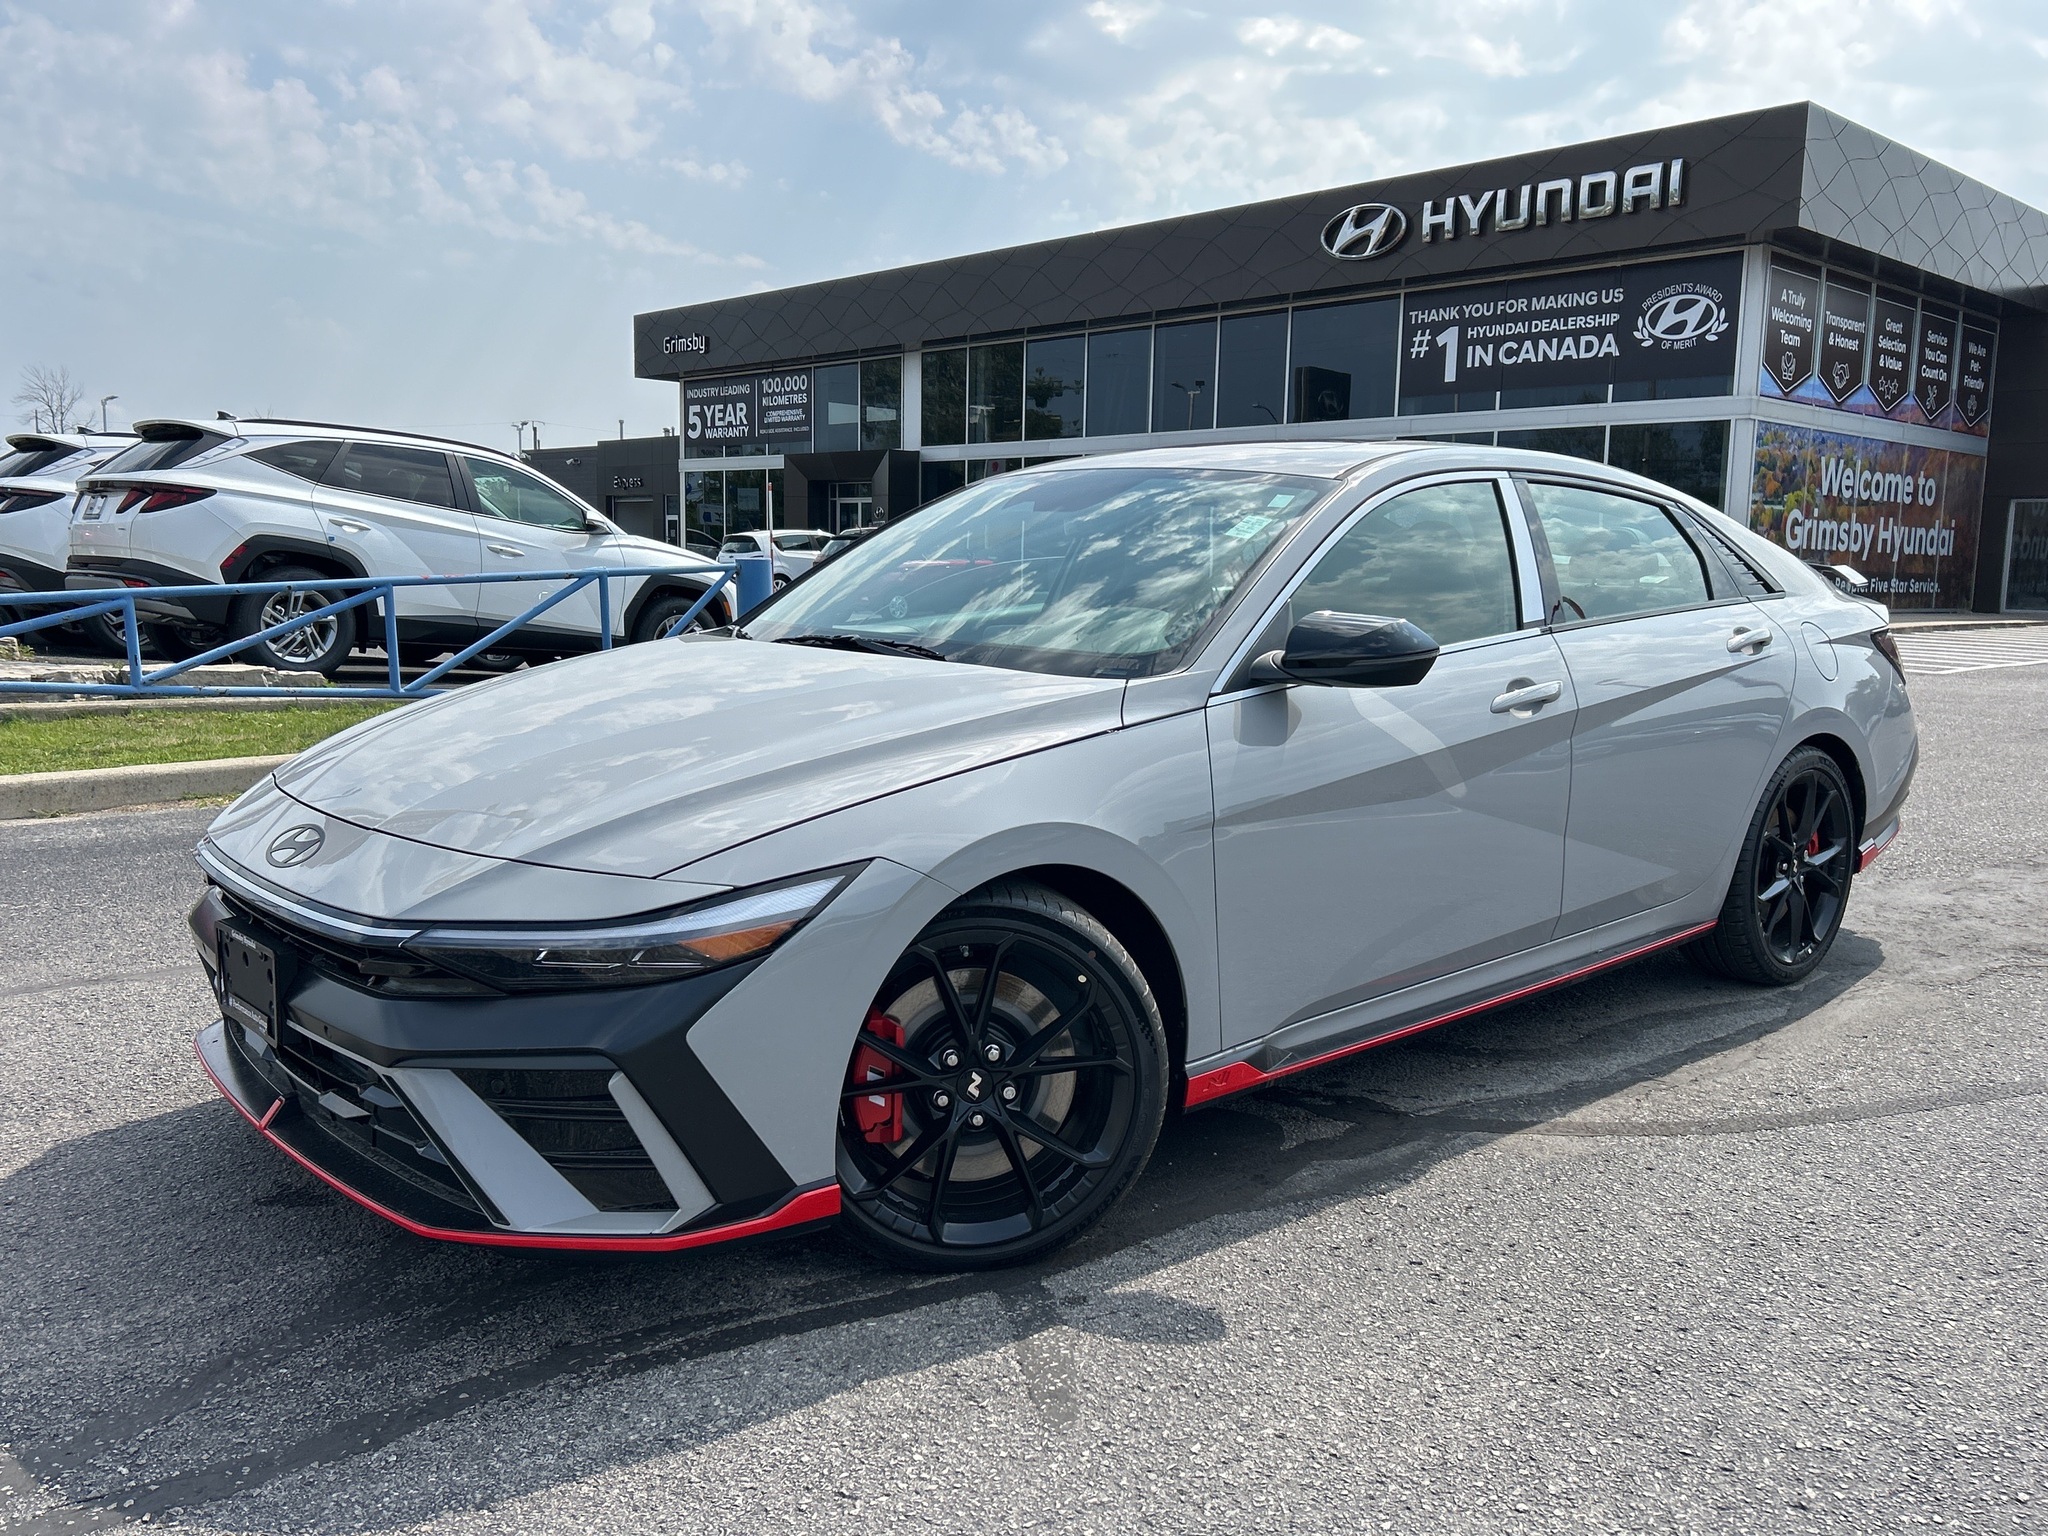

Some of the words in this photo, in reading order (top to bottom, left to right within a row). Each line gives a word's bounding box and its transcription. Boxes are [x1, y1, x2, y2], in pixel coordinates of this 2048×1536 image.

[1422, 158, 1685, 243] HYUNDAI
[1694, 284, 1723, 303] AWARD
[1781, 288, 1787, 303] A
[1788, 290, 1806, 310] Truly
[1409, 306, 1460, 324] THANK
[1462, 302, 1494, 318] YOU
[1497, 299, 1528, 315] FOR
[1531, 291, 1598, 311] MAKING
[1602, 288, 1624, 303] US
[1771, 306, 1812, 332] Welcoming
[1826, 311, 1865, 333] Transparent
[1885, 318, 1903, 334] Great
[663, 333, 706, 354] Grimsby
[1661, 340, 1672, 350] OF
[1673, 337, 1697, 350] MERIT
[1780, 329, 1800, 347] Team
[1828, 332, 1834, 345] &
[1835, 333, 1859, 351] Honest
[1878, 335, 1906, 353] Selection
[1927, 330, 1948, 346] Service
[1410, 326, 1459, 383] #1
[1467, 321, 1528, 339] HYUNDAI
[1531, 313, 1620, 333] DEALERSHIP
[1466, 344, 1494, 368] IN
[1499, 333, 1620, 365] CANADA
[1925, 347, 1936, 361] You
[1936, 350, 1948, 364] Can
[1879, 354, 1885, 367] &
[1885, 355, 1902, 371] Value
[1921, 365, 1939, 380] Count
[1939, 368, 1947, 382] On
[687, 387, 719, 399] INDUSTRY
[720, 384, 750, 396] LEADING
[762, 374, 808, 394] 100,000
[762, 393, 808, 407] KILOMETRES
[687, 404, 702, 439] 5
[704, 402, 748, 427] YEAR
[705, 426, 749, 439] WARRANTY
[1821, 456, 1913, 506] Welcome
[1918, 470, 1936, 507] to
[1785, 508, 1875, 561] Grimsby
[1877, 516, 1955, 562] Hyundai
[1870, 576, 1888, 593] Five
[1890, 578, 1908, 593] Star
